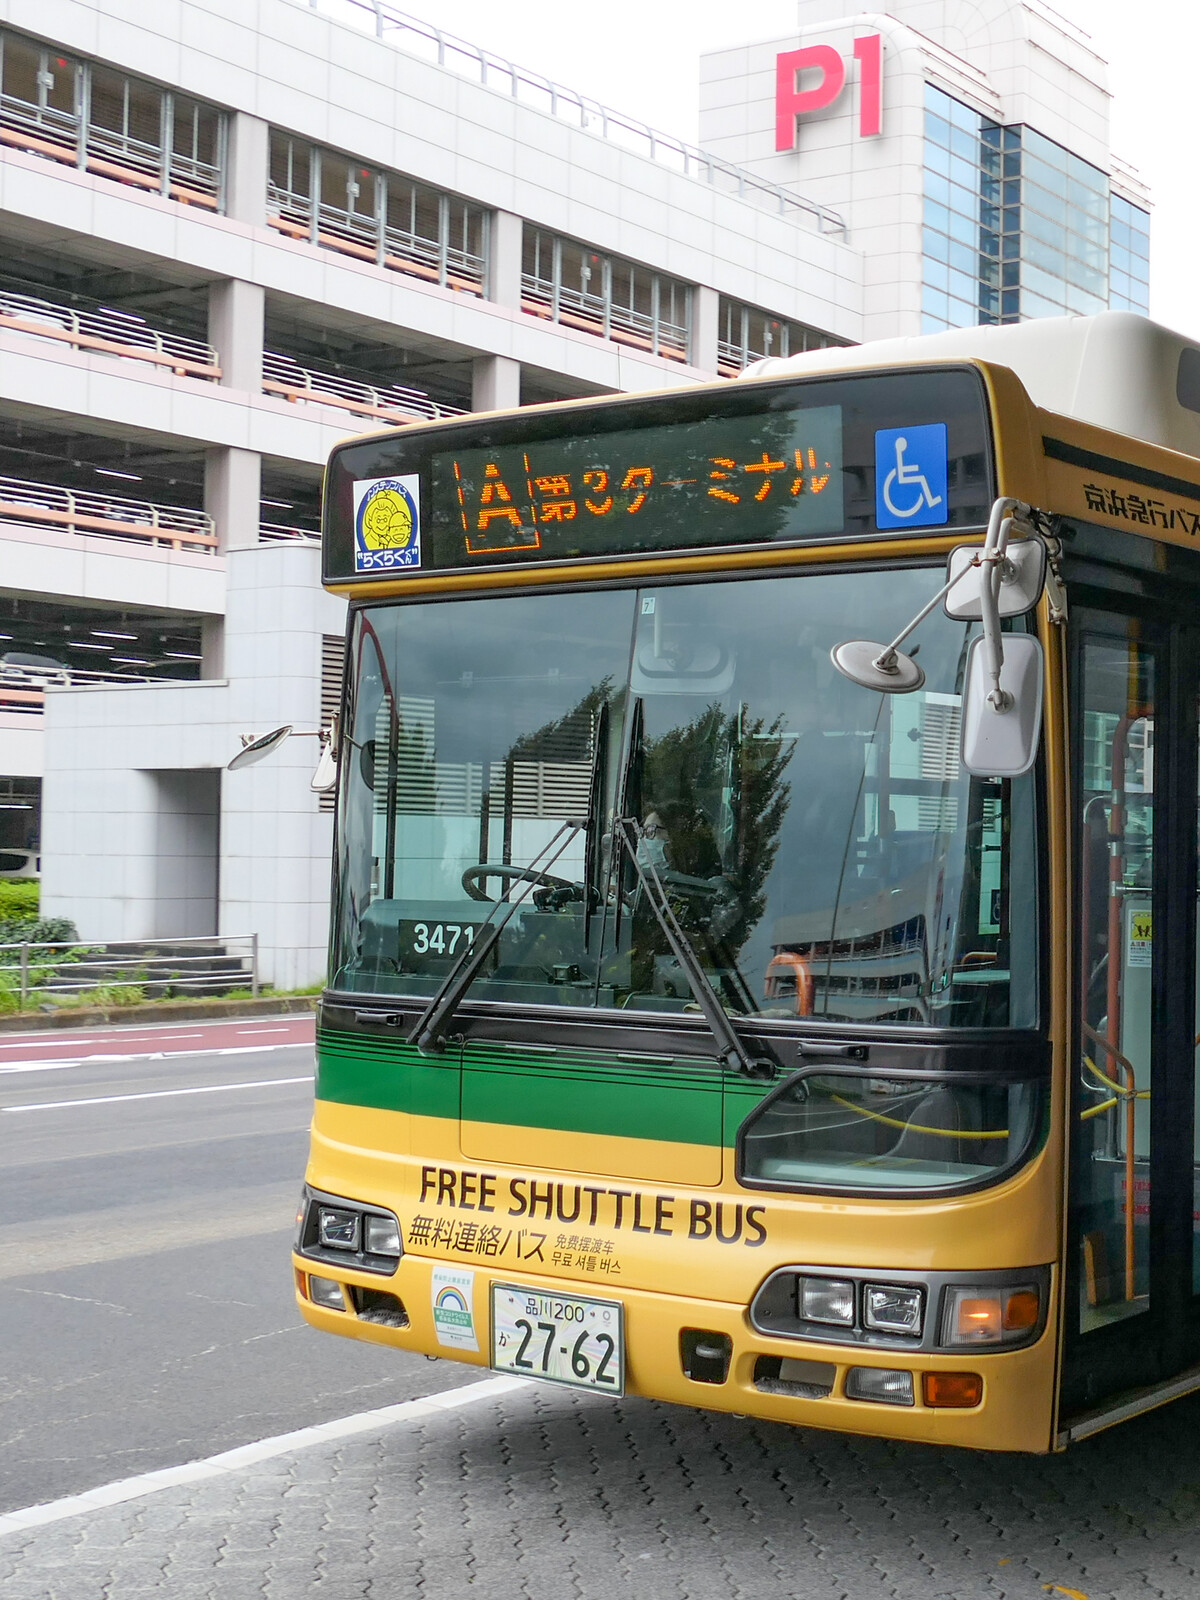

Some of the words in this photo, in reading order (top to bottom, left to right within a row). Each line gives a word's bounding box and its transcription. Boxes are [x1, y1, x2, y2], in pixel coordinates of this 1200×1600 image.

[775, 33, 884, 152] P1
[477, 462, 525, 538] A
[534, 446, 832, 523] 第3ターミナル
[413, 923, 474, 956] 3471
[408, 1213, 547, 1263] 無料連絡バス
[419, 1165, 498, 1213] FREE
[508, 1176, 675, 1237] SHUTTLE
[687, 1198, 768, 1247] BUS
[551, 1251, 573, 1267] 무료
[575, 1254, 597, 1272] 셔틀
[599, 1257, 621, 1274] 버스
[554, 1233, 615, 1256] 免费摆渡车
[514, 1318, 615, 1385] 27-62
